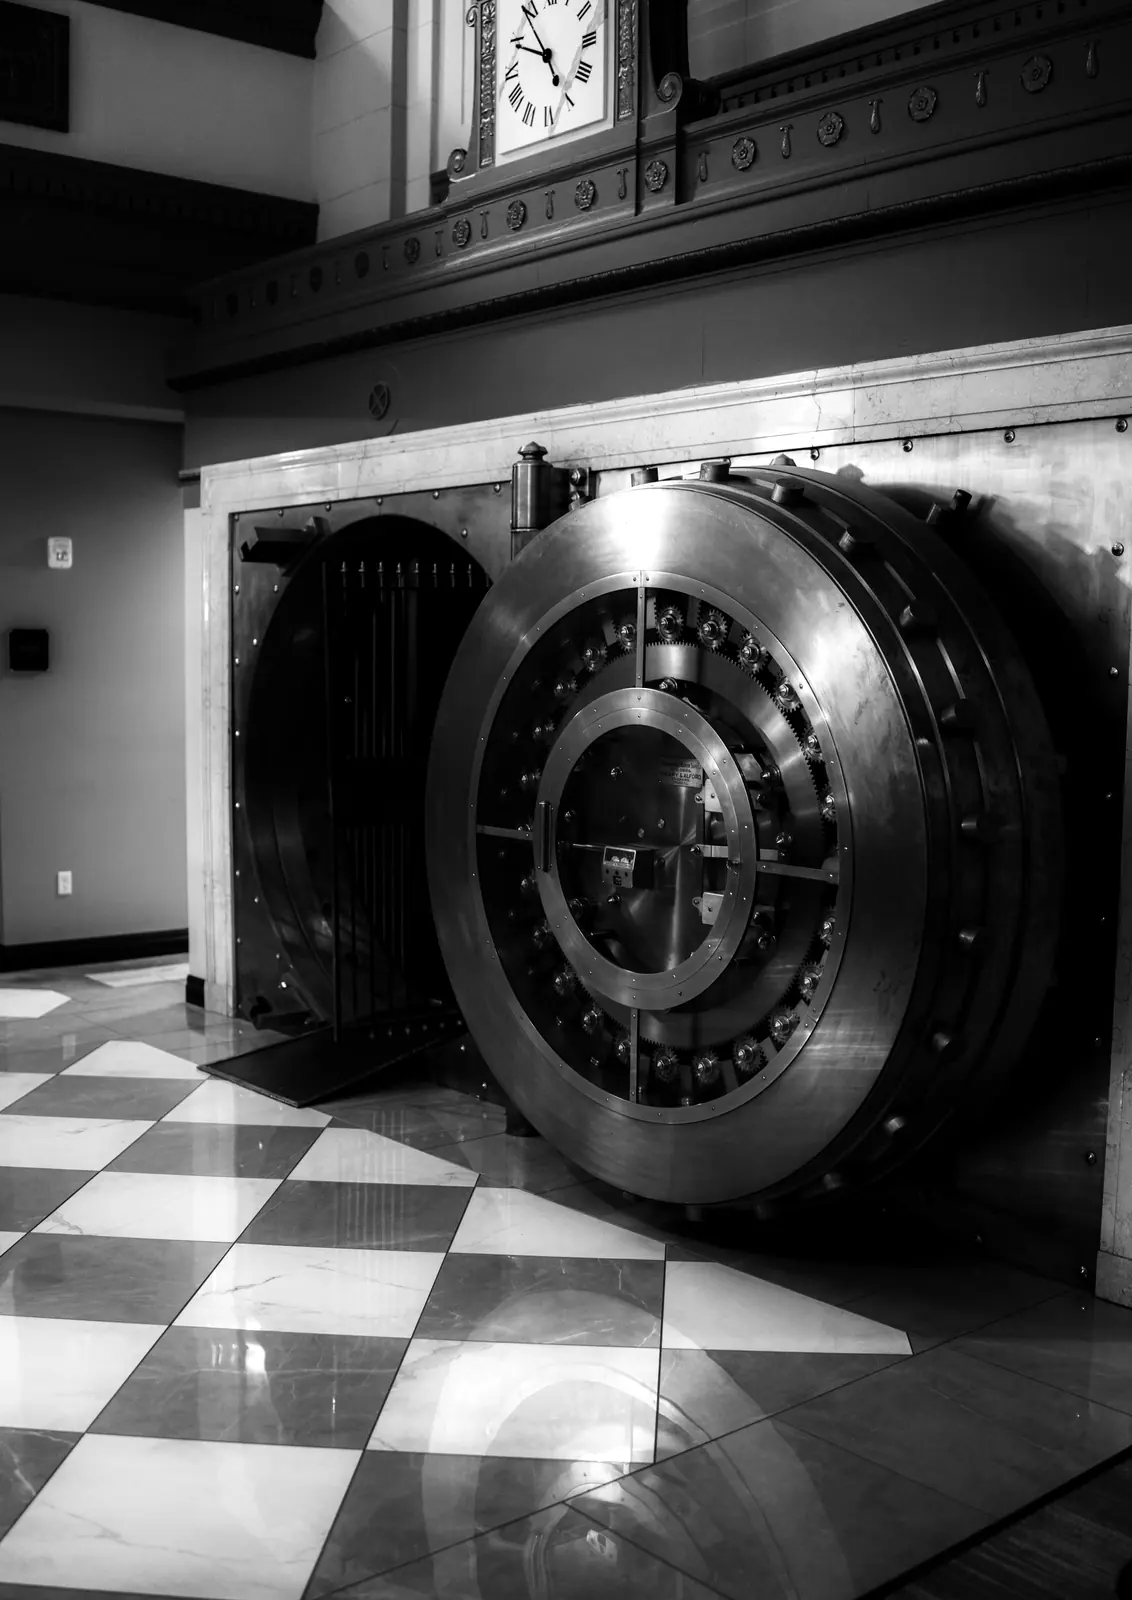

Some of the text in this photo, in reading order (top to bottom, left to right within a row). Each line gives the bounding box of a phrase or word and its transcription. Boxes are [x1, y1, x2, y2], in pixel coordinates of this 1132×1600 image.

[576, 0, 592, 21] II
[582, 30, 597, 49] III
[505, 60, 519, 81] IX
[574, 60, 593, 83] IIII
[508, 82, 525, 113] VIII
[565, 92, 575, 112] V
[521, 101, 537, 127] VII
